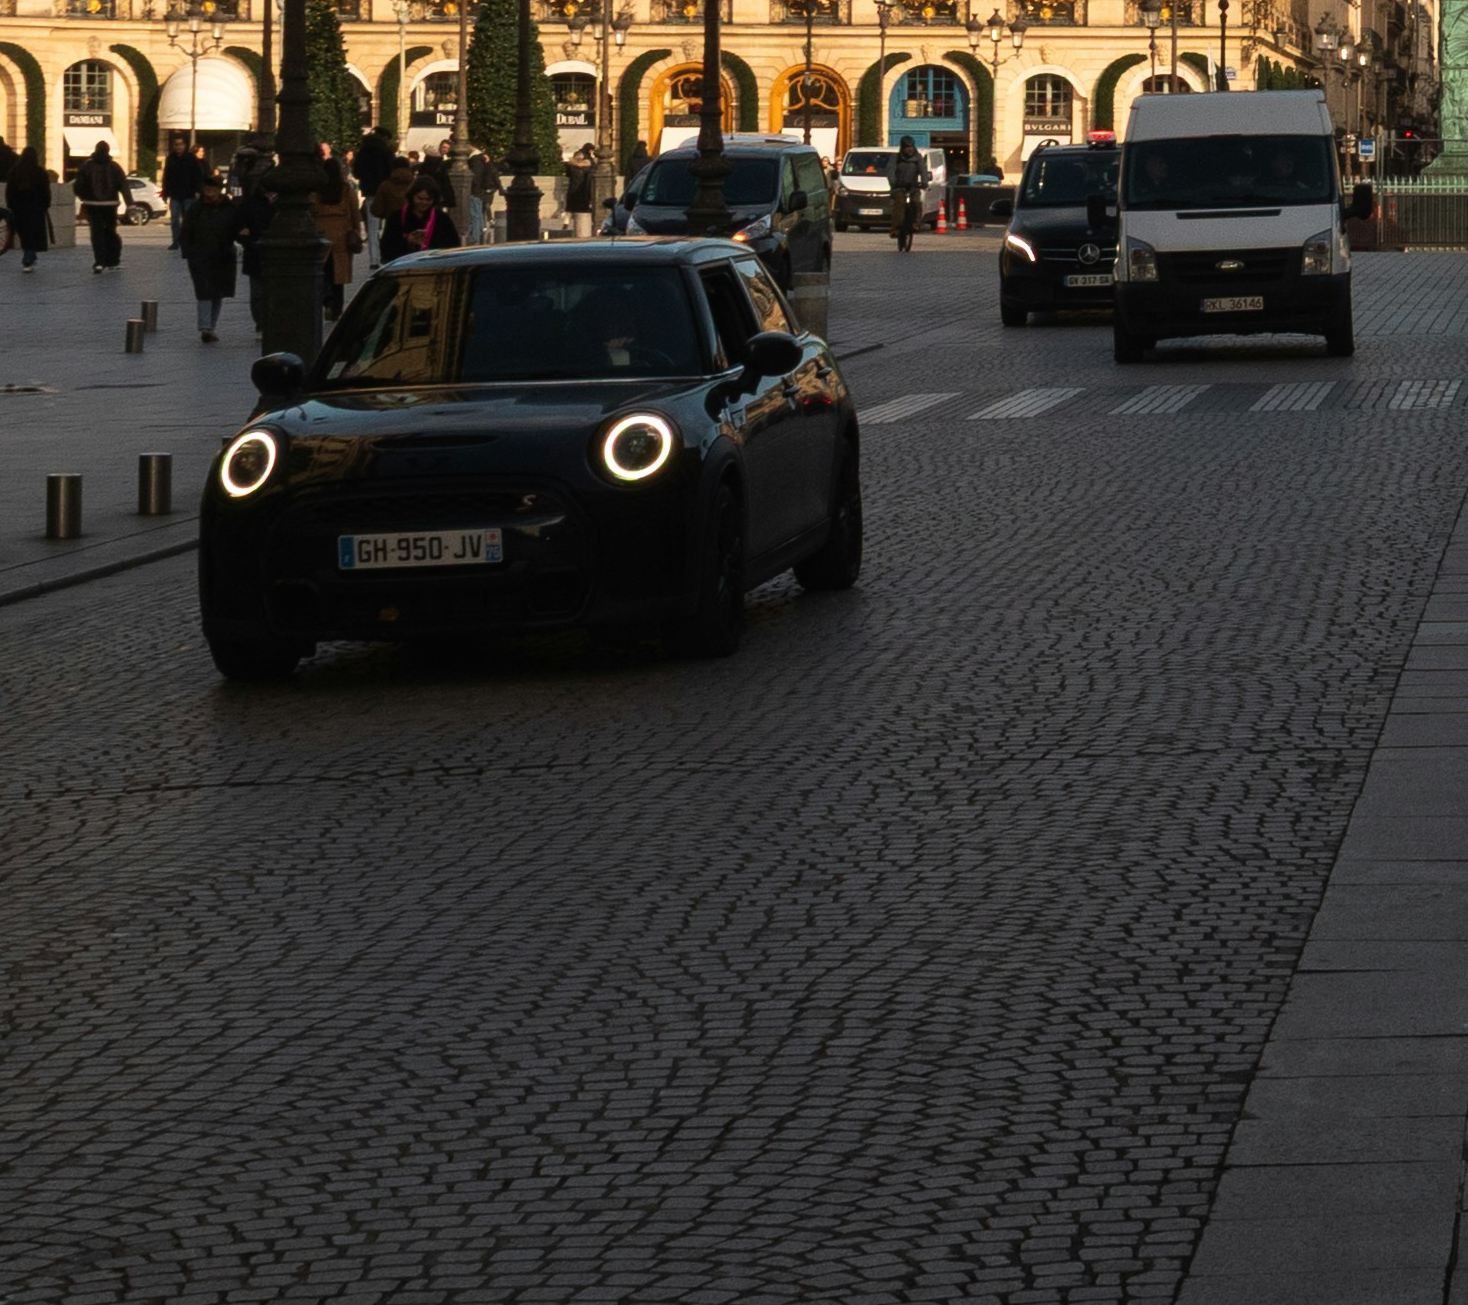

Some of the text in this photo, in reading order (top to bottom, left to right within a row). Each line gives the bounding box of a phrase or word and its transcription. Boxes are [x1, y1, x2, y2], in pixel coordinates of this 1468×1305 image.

[69, 115, 103, 125] DAMIANI
[674, 115, 702, 126] Carti
[793, 115, 828, 127] Catier
[1024, 123, 1072, 131] BVLGARI
[1205, 297, 1262, 311] RKL 36146
[357, 534, 482, 563] GH-950-JV
